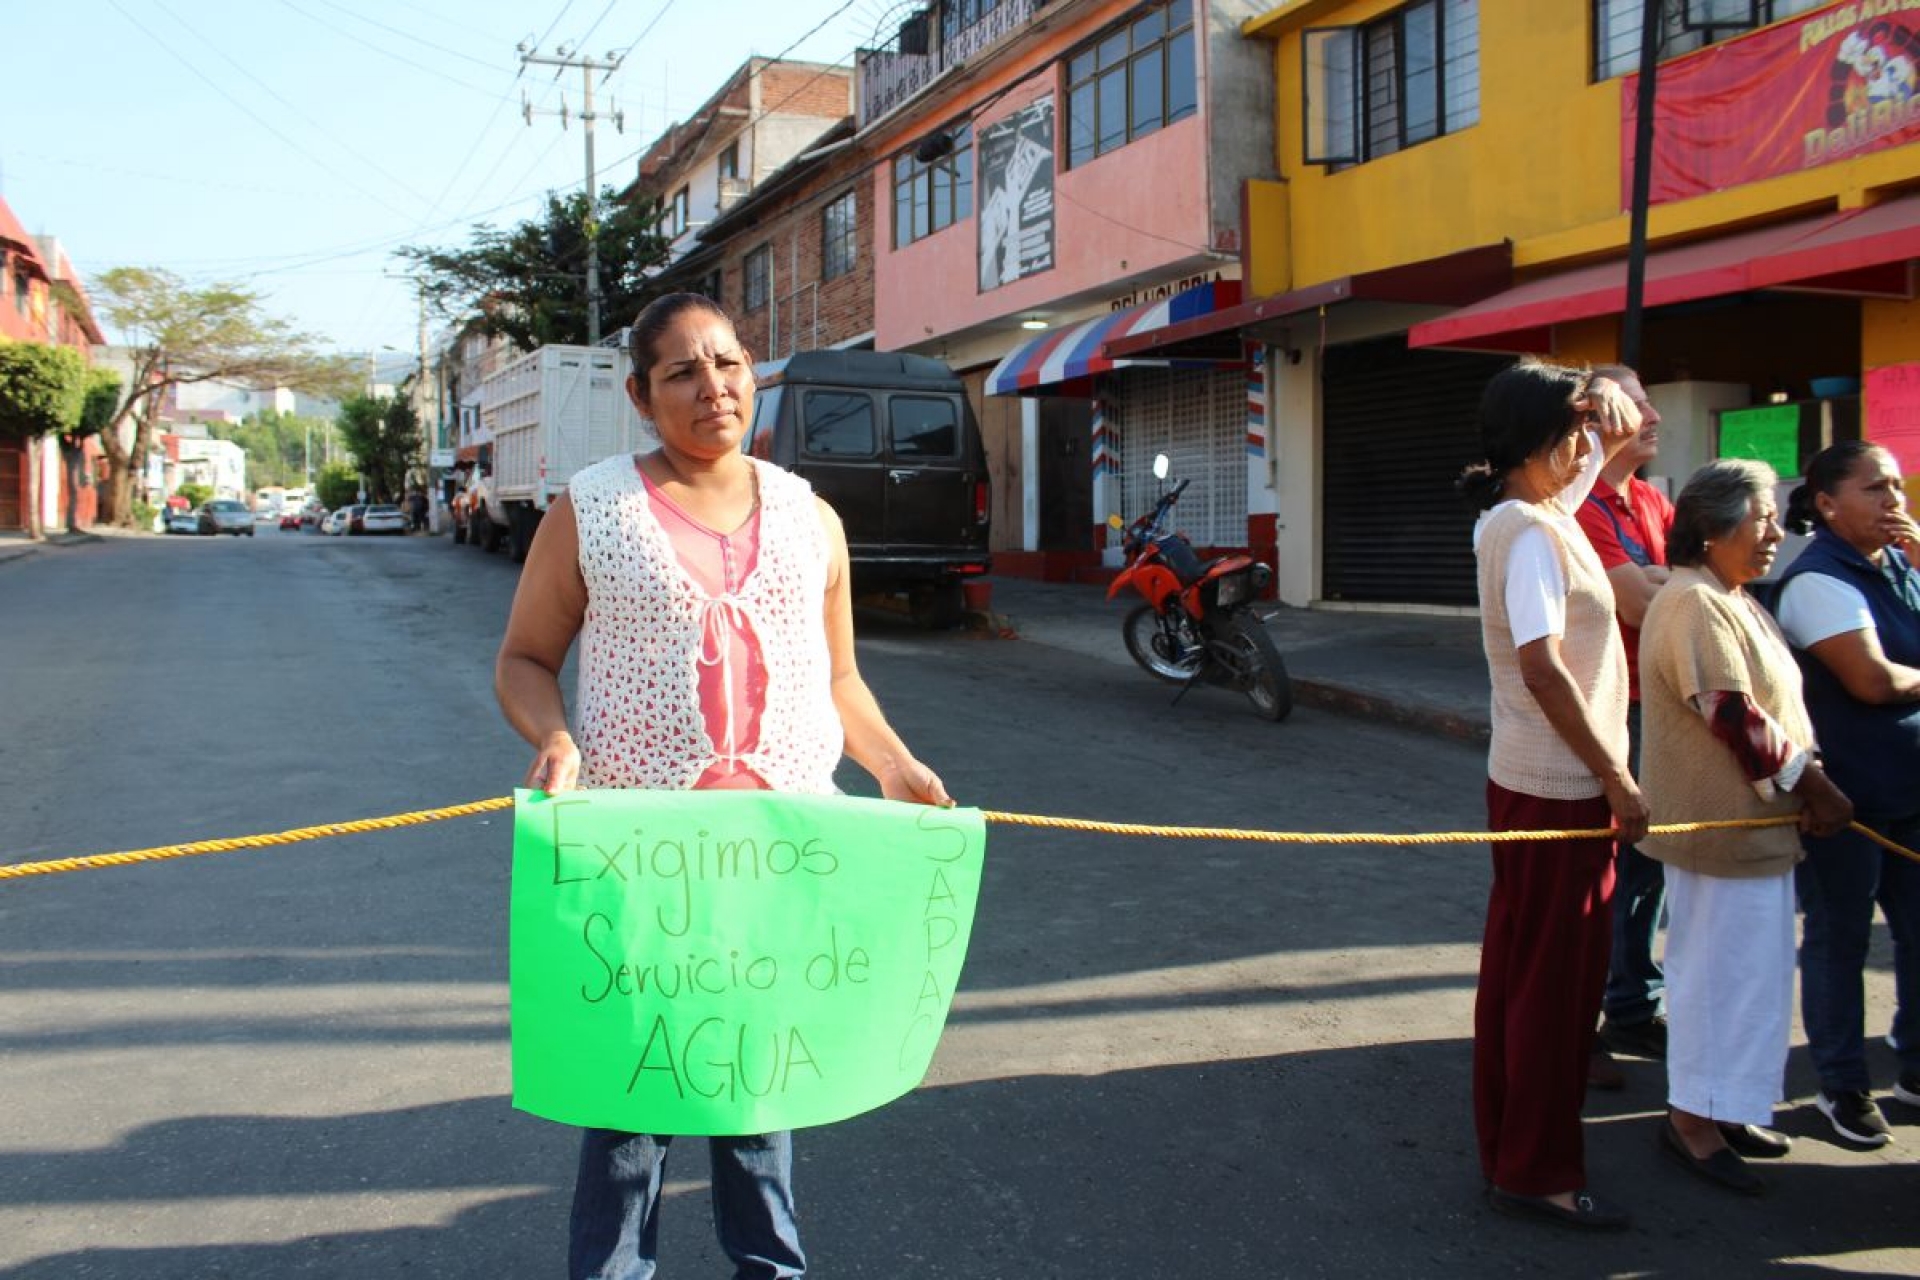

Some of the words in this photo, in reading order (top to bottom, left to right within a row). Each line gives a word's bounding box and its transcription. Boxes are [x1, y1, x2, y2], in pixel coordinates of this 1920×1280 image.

[552, 800, 839, 937] Exigimos
[581, 912, 779, 1004] Servicio
[805, 925, 870, 992] de
[897, 807, 969, 1073] SAPAC
[626, 1012, 823, 1103] AGUA
